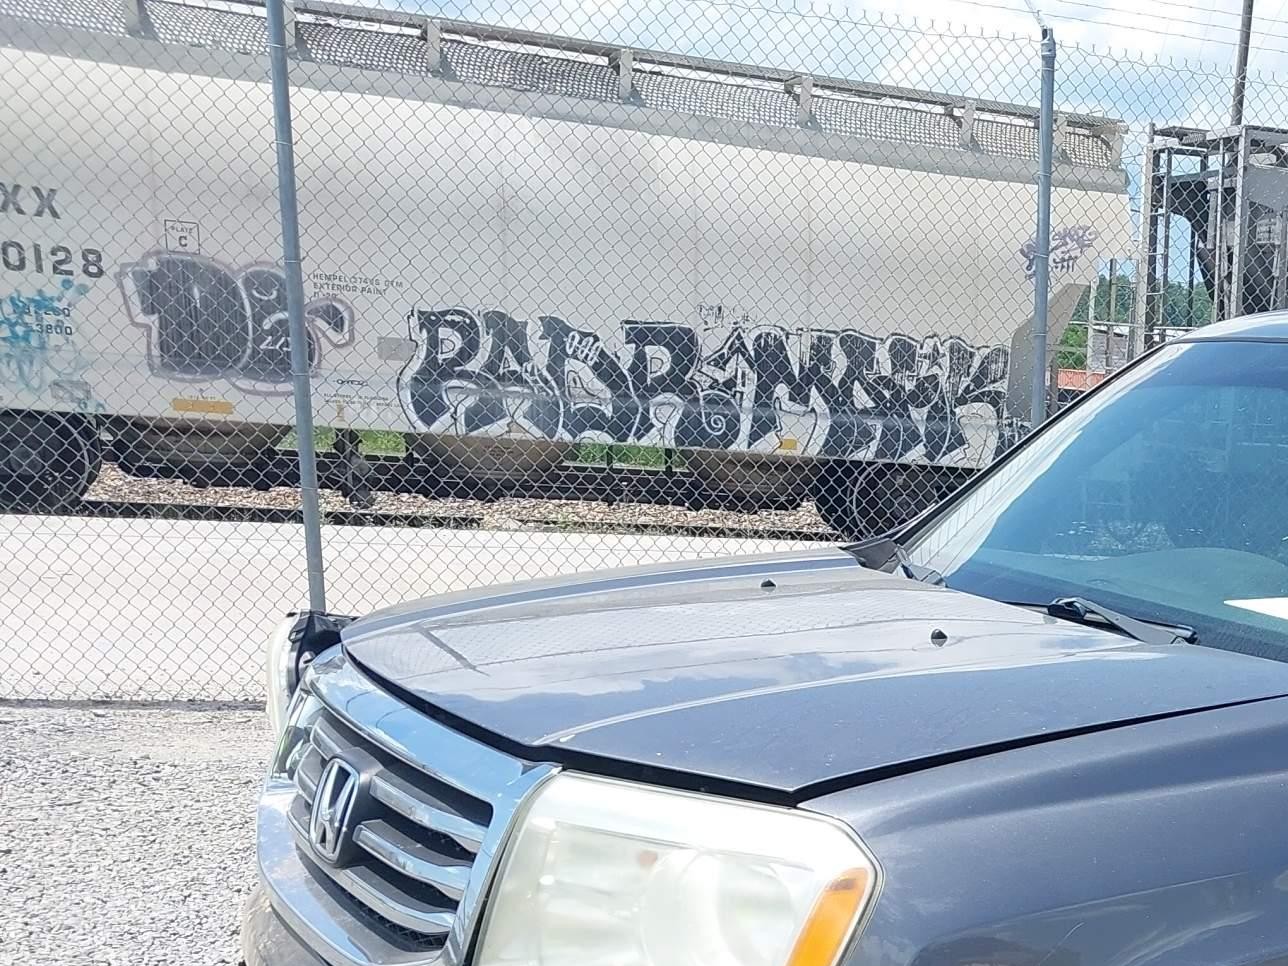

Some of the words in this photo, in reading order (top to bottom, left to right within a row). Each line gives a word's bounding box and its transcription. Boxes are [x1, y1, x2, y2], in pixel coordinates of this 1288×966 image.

[178, 235, 188, 248] C
[1, 240, 105, 279] 0128
[312, 273, 349, 284] HEMPEL
[313, 282, 358, 293] EXTERIOR
